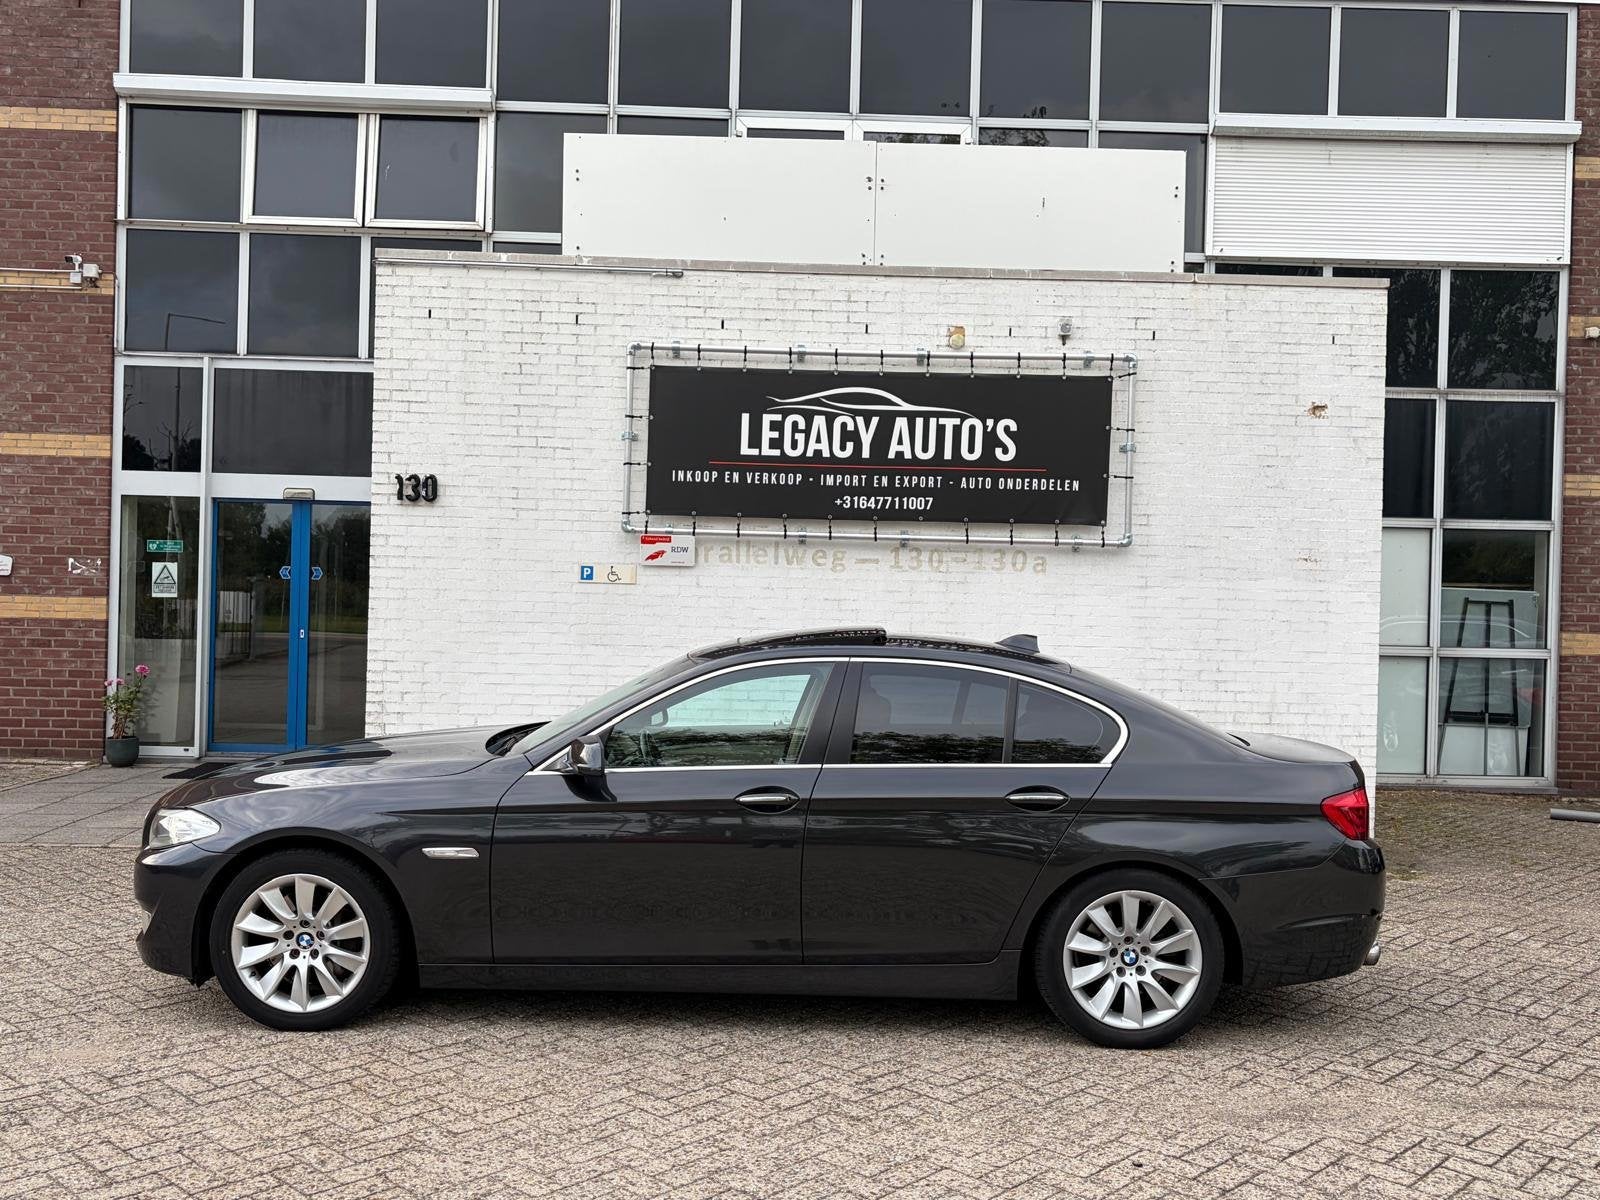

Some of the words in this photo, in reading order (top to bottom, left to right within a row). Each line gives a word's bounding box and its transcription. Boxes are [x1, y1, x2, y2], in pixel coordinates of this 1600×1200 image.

[739, 412, 880, 459] LEGACY
[887, 416, 1018, 462] AUTO'S
[395, 473, 437, 502] 130
[672, 470, 718, 483] INKOOP
[724, 471, 739, 484] EN
[746, 472, 803, 485] VERKOOP
[820, 474, 867, 487] IMPORT
[873, 475, 888, 488] EN
[895, 476, 943, 488] EXPORT
[960, 477, 993, 489] AUTO
[998, 478, 1080, 491] ONDERDELEN
[834, 495, 934, 510] +31647711007
[695, 539, 846, 573] rallelweg
[583, 568, 591, 579] P
